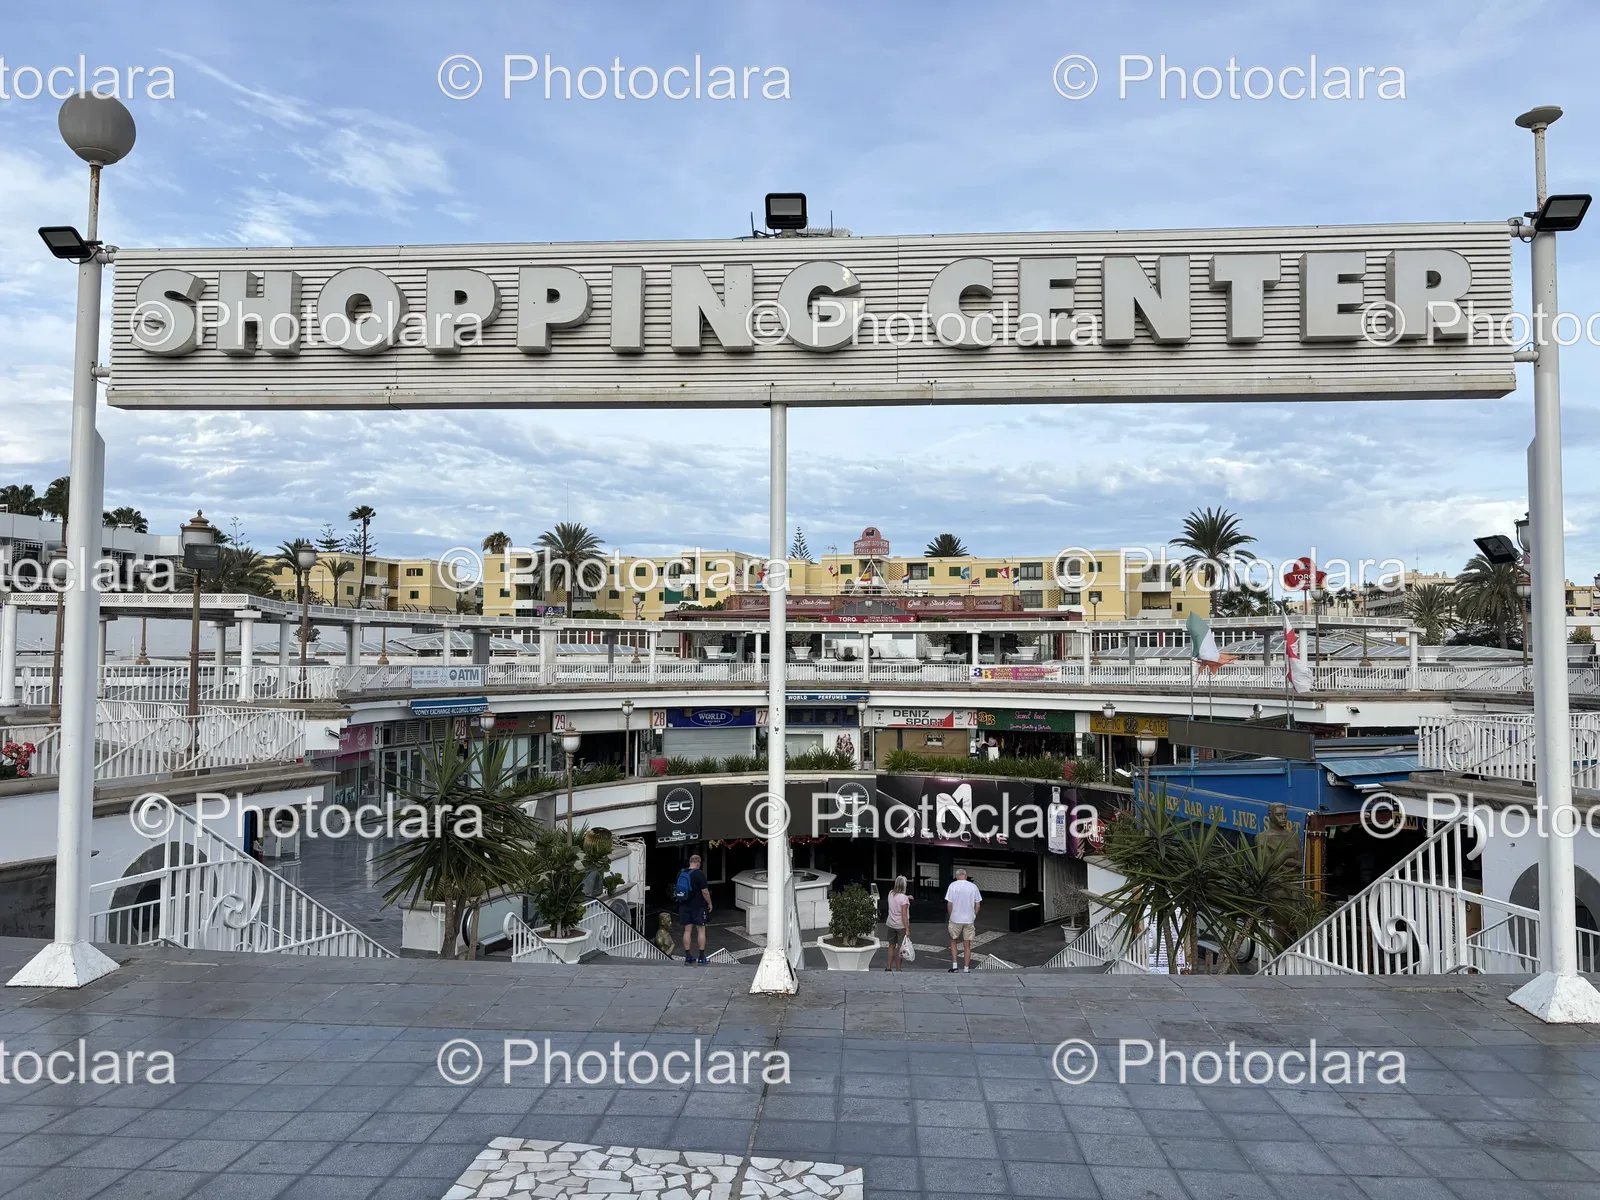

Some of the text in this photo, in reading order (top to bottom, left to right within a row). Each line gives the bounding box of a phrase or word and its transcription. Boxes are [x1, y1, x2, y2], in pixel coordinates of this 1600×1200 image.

[131, 249, 1476, 358] SHOPPING CENTER
[458, 669, 479, 680] ATM
[974, 668, 992, 679] 3B
[654, 711, 665, 727] 28
[757, 710, 769, 724] 27
[893, 710, 930, 718] DENIZ
[555, 714, 565, 730] 29
[905, 718, 945, 726] SPORT
[375, 727, 383, 744] 31
[1184, 799, 1203, 817] BAR
[1232, 809, 1258, 830] LIVE
